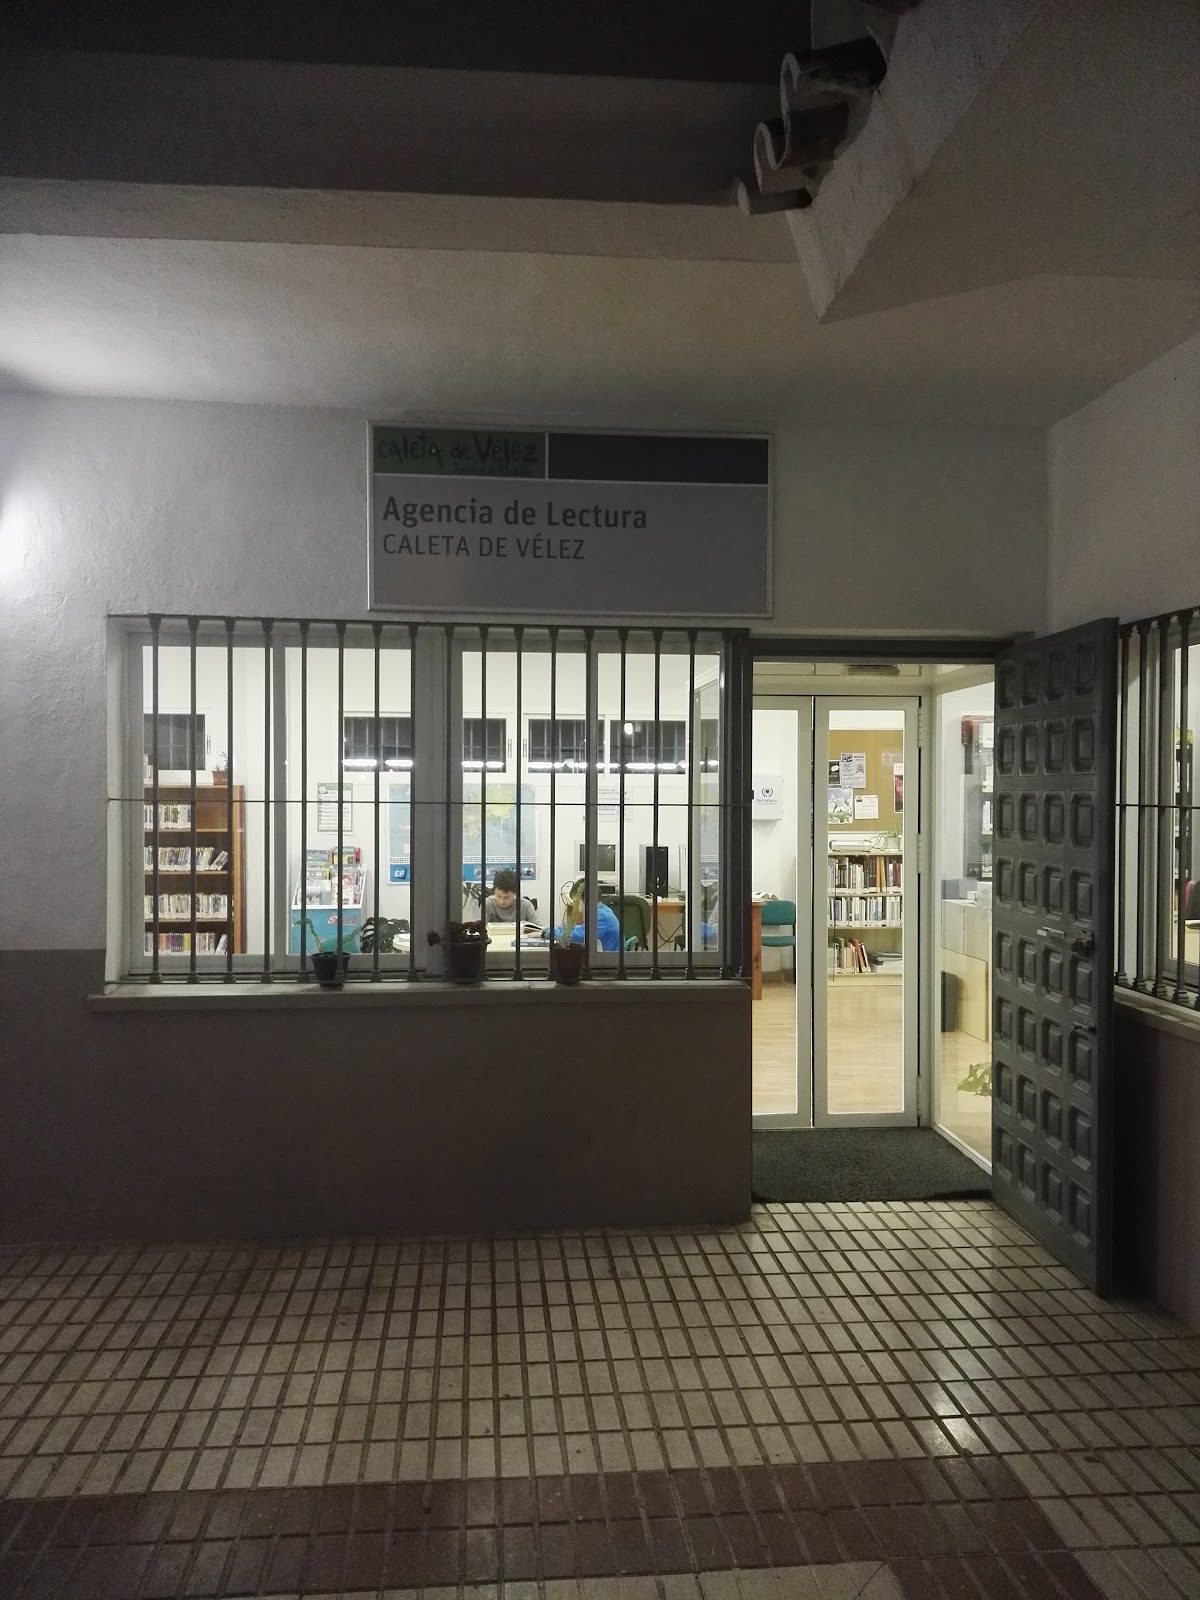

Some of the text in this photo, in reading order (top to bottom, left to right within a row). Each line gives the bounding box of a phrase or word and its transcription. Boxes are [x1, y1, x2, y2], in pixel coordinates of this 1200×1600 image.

[450, 439, 471, 460] de
[383, 496, 648, 529] Agencia de Lectura
[383, 533, 586, 560] CALETA DE VÉLEZ
